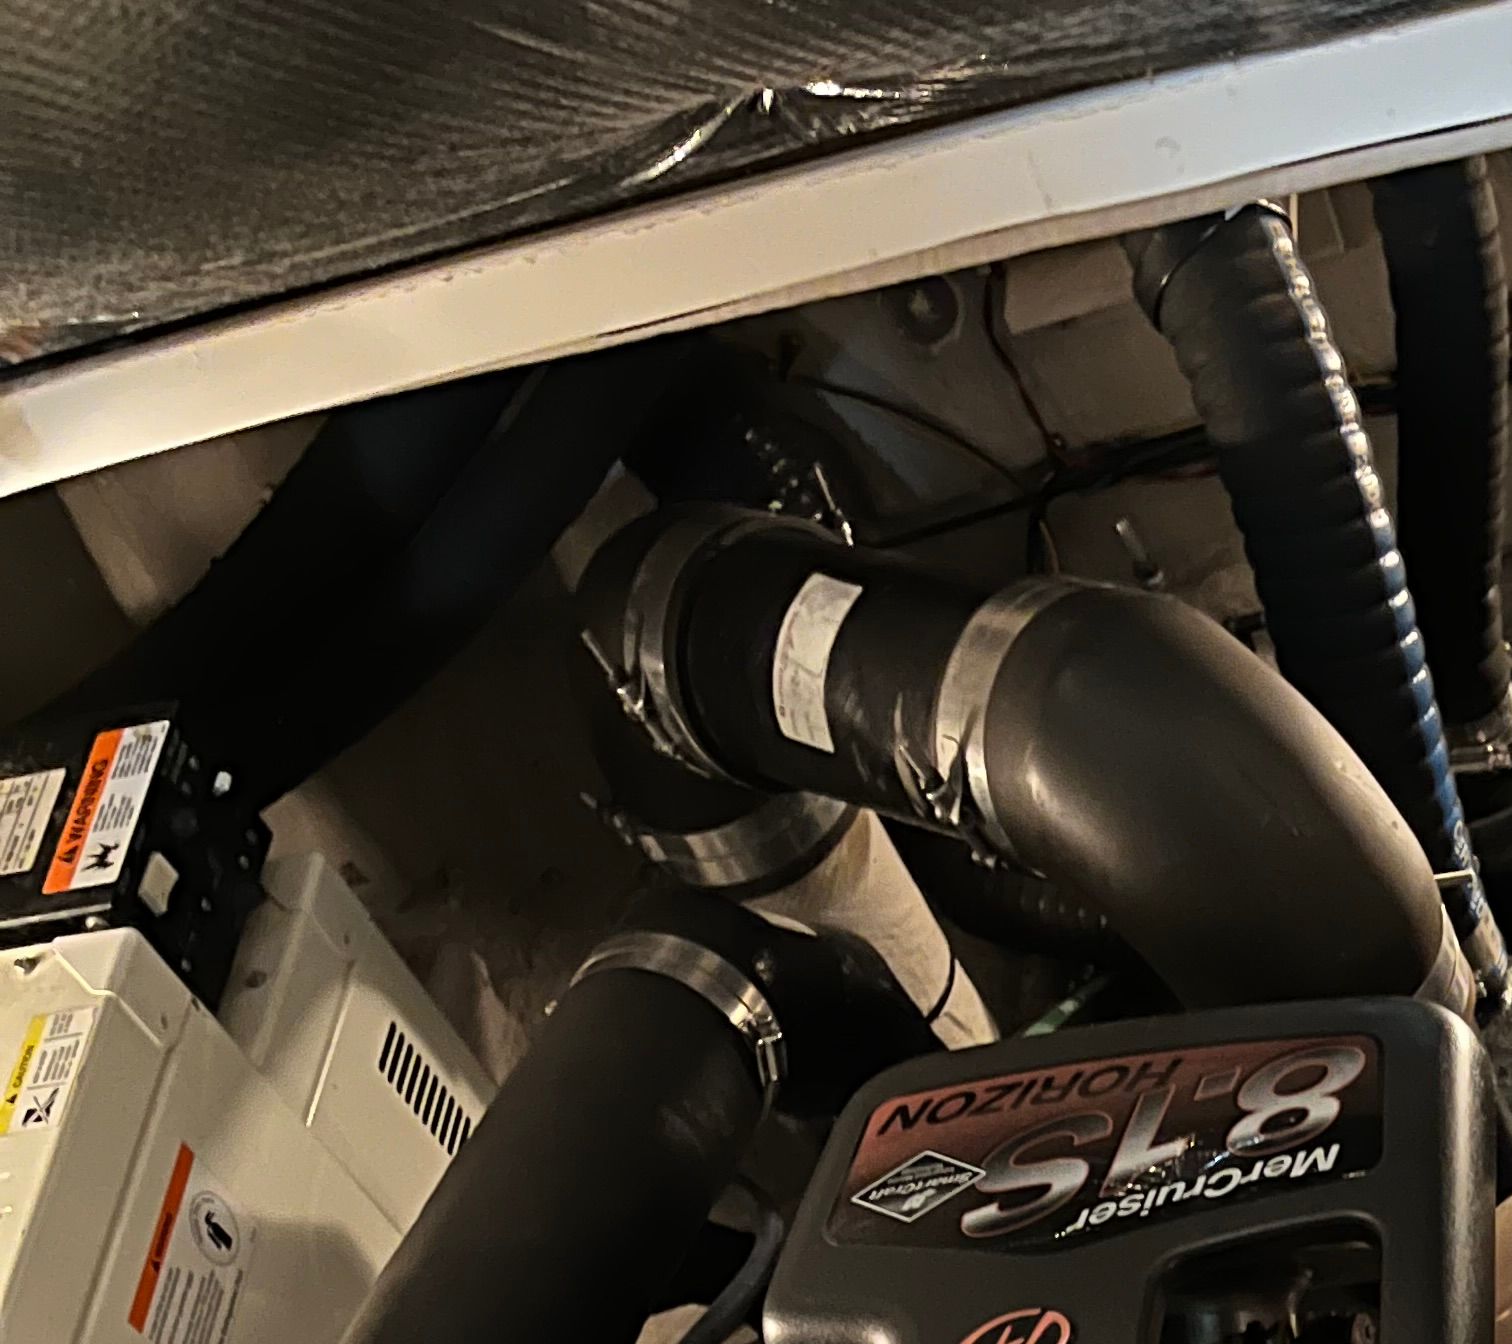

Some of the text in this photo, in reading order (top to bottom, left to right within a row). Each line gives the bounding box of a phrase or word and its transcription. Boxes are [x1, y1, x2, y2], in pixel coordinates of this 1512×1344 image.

[64, 755, 109, 846] WARNING
[11, 1043, 35, 1089] CAUTION
[878, 1057, 1182, 1137] HORIZON
[960, 1045, 1366, 1238] 8.1S
[1066, 1143, 1341, 1233] MerCruiser
